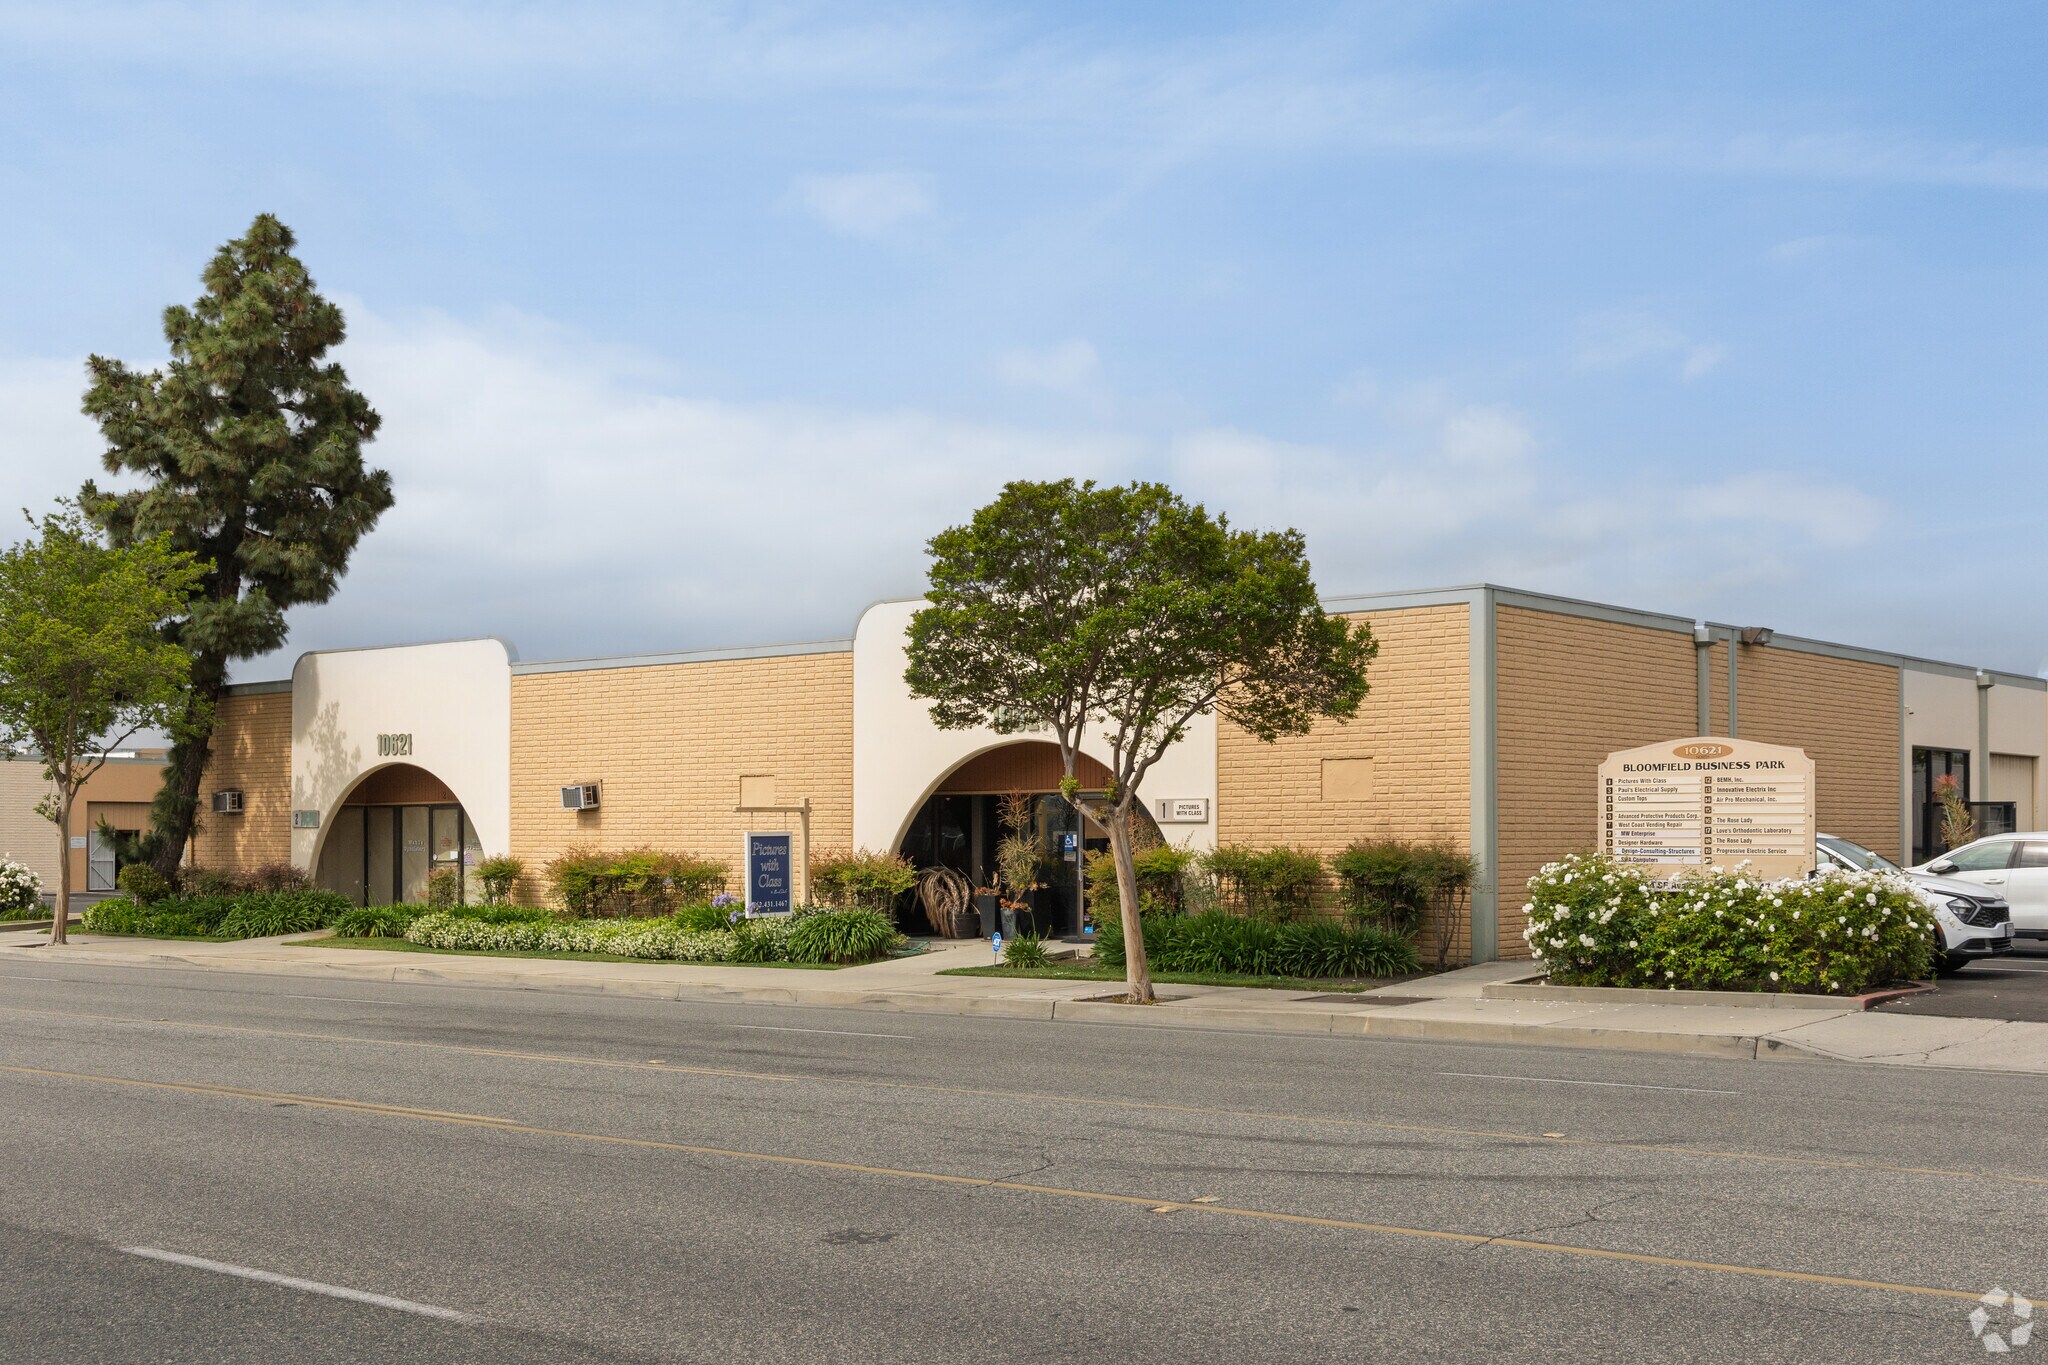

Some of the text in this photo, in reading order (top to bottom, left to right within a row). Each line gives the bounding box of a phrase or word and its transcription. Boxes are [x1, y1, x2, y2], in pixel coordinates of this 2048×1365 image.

[377, 733, 412, 756] 10621
[1684, 746, 1722, 755] 10621
[1623, 760, 1785, 772] BLOOMFIELD BUSINESS PARK
[1162, 802, 1166, 818] 1
[752, 842, 787, 855] Pictures
[761, 859, 779, 871] with
[758, 874, 782, 887] Class
